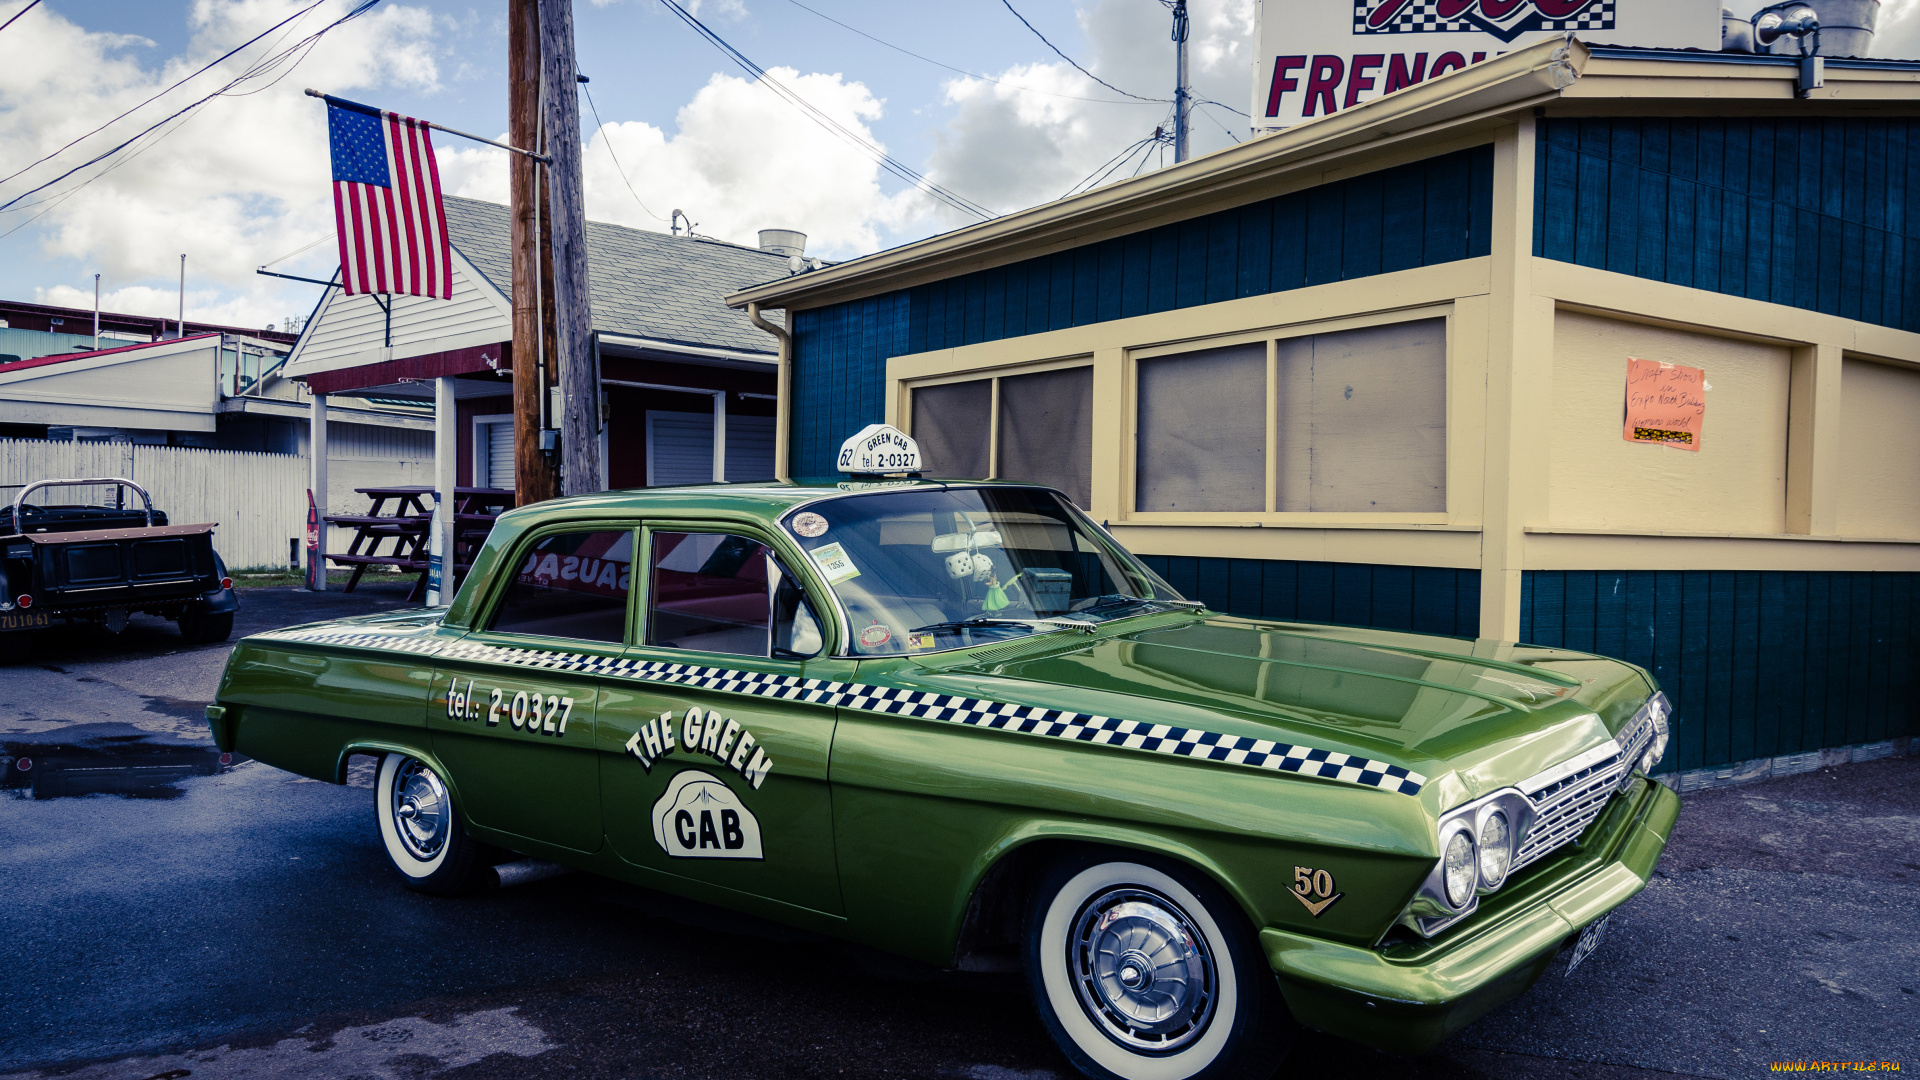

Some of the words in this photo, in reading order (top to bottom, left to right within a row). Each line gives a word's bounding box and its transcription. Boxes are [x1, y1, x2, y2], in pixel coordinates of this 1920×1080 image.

[1265, 51, 1510, 117] FREN
[840, 448, 853, 466] 62
[867, 433, 891, 451] GREEN
[893, 435, 908, 451] CAB
[862, 453, 875, 467] tel.
[878, 453, 915, 467] 2-0327
[827, 560, 845, 570] 1355
[488, 687, 574, 734] 2-0327
[625, 710, 676, 772] THE
[684, 706, 774, 790] GREEN
[674, 808, 744, 850] CAB
[1294, 866, 1333, 898] 50
